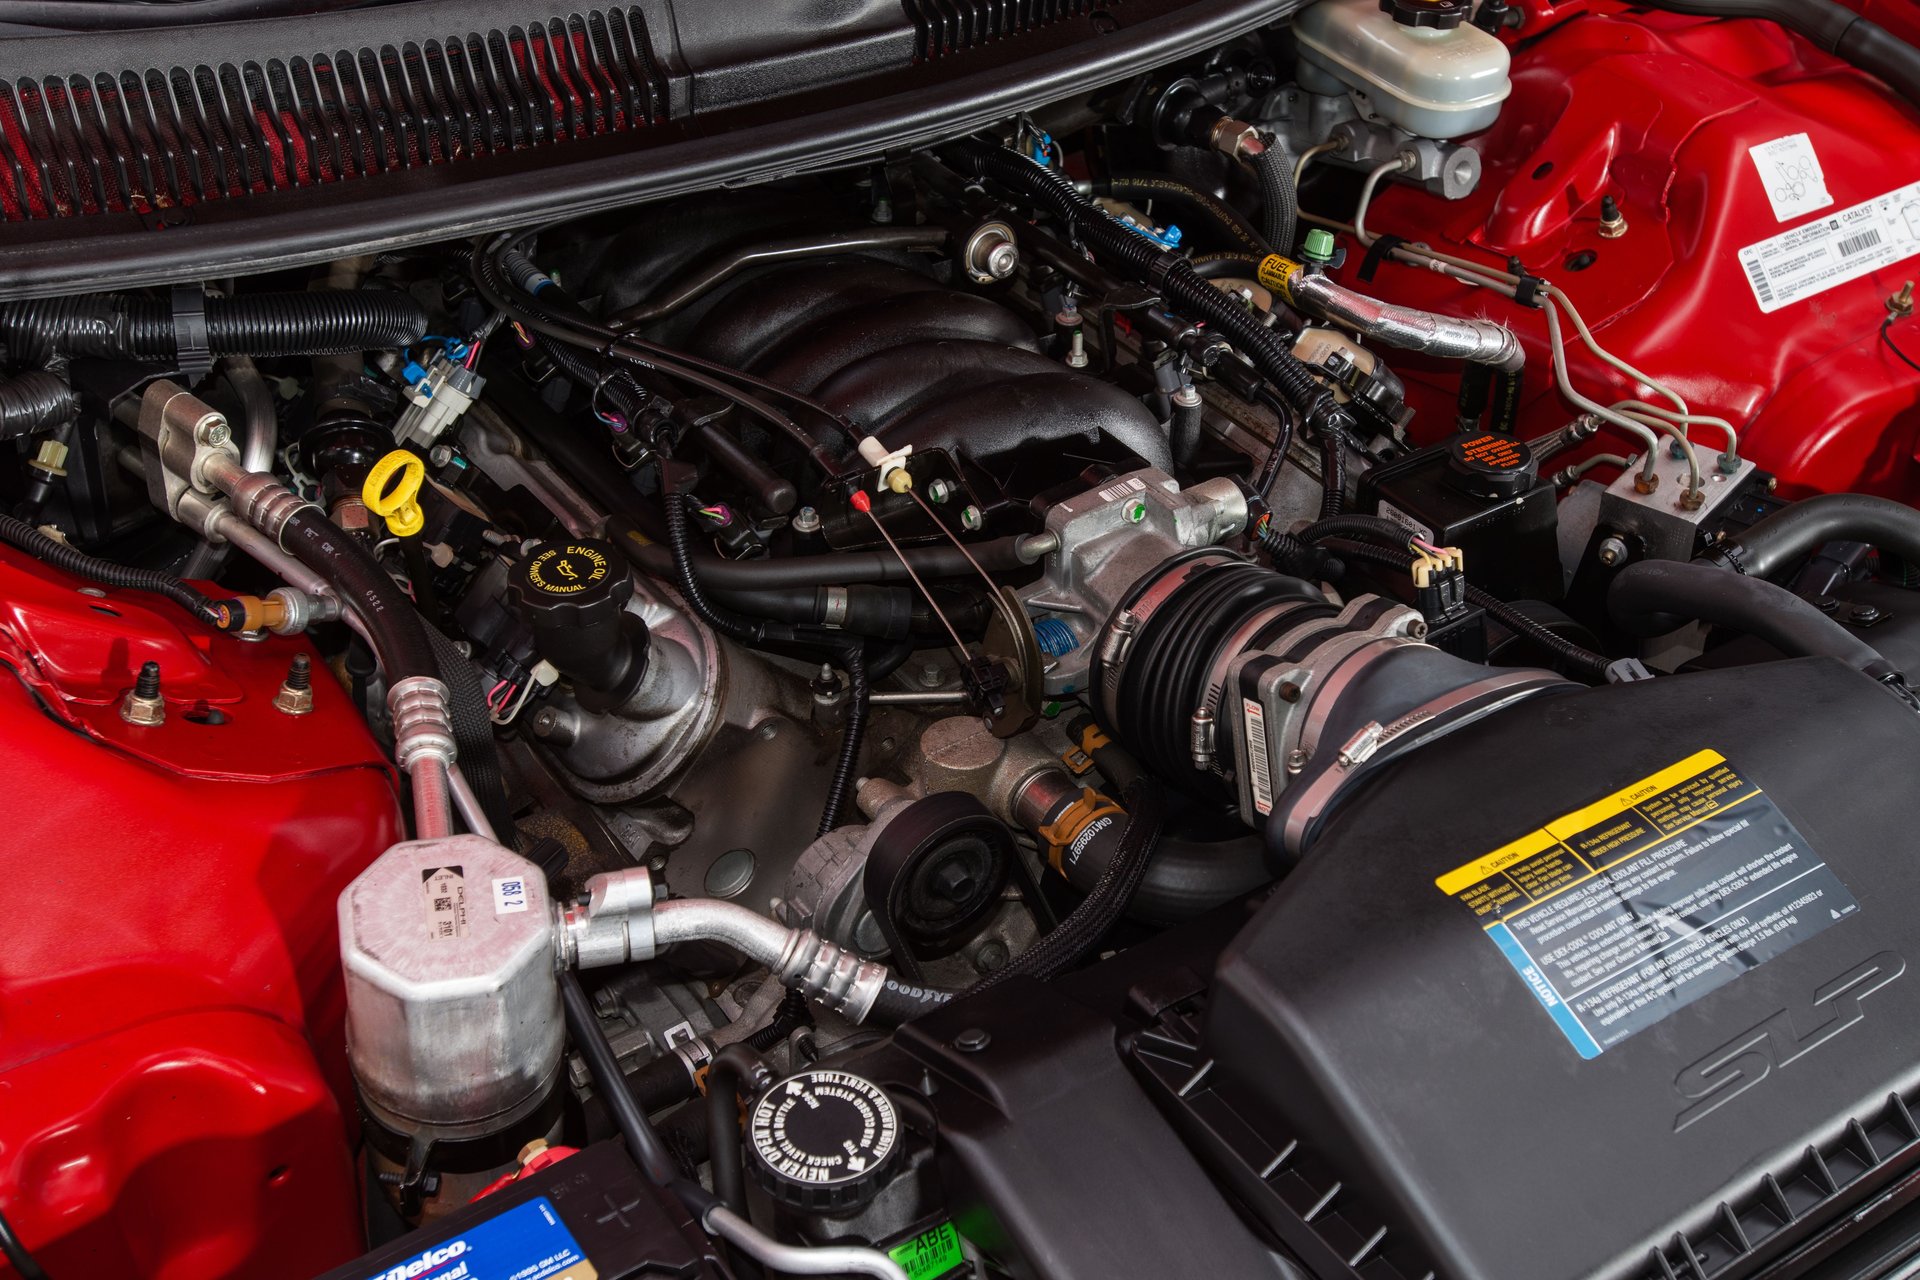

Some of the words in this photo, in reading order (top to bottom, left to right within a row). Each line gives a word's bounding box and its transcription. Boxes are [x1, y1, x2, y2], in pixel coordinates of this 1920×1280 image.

[1842, 205, 1872, 221] CATALYST
[1780, 237, 1799, 247] CONTROL
[1801, 225, 1829, 239] INFORMATION
[1783, 231, 1800, 240] VEHICLE
[1802, 222, 1822, 232] EMISSION
[1261, 267, 1286, 281] FLAMMABLE
[1265, 258, 1289, 274] FUEL
[1462, 435, 1494, 449] POWER
[1465, 440, 1508, 456] STEERING
[1491, 442, 1520, 453] OVERFILL
[1497, 449, 1513, 457] ONLY
[1489, 453, 1521, 466] APPROVED
[1500, 459, 1519, 468] FLUID
[538, 550, 556, 561] SEE
[567, 546, 606, 567] ENGINE
[588, 568, 606, 580] OIL
[529, 560, 546, 587] OWNER'S
[544, 584, 586, 593] MANUAL
[366, 590, 384, 613] 0522
[1246, 703, 1260, 712] FLOW
[1629, 784, 1657, 800] CAUTION
[1069, 817, 1113, 865] GM10295971
[1590, 845, 1609, 857] UNDER
[1606, 839, 1621, 849] HIGH
[1618, 826, 1646, 843] PRESSURE
[1597, 821, 1632, 841] REFRIGERANT
[1489, 851, 1519, 868] CAUTION
[501, 881, 522, 896] 058
[1512, 918, 1530, 930] THIS
[1527, 905, 1555, 923] VEHICLE
[1552, 890, 1584, 910] REQUIRES
[1586, 876, 1614, 893] SPECIAL
[1611, 862, 1642, 881] COOLANT
[1639, 856, 1654, 867] FILL
[1650, 839, 1688, 861] PROCEDURE
[1528, 922, 1547, 934] Read
[1543, 912, 1567, 927] Service
[1564, 901, 1587, 916] Manual
[1594, 888, 1614, 901] before
[1612, 879, 1632, 893] adding
[1639, 865, 1661, 878] coolant
[1664, 851, 1687, 866] system.
[1683, 843, 1704, 856] Failure
[1707, 832, 1725, 844] follow
[1721, 823, 1743, 837] special
[457, 886, 466, 925] DELPHI
[1536, 925, 1567, 944] procedure
[1563, 917, 1581, 929] could
[1579, 909, 1597, 921] result
[1600, 896, 1623, 910] serious
[1620, 885, 1644, 901] damage
[1656, 868, 1679, 883] engine.
[1568, 948, 1591, 963] vehicle
[1598, 929, 1626, 947] extended
[1670, 893, 1697, 911] improper
[1717, 871, 1738, 885] coolant
[1744, 856, 1766, 871] shorten
[1772, 842, 1793, 856] coolant
[1573, 956, 1601, 973] requiring
[1598, 945, 1621, 960] change
[1618, 936, 1637, 949] much
[1748, 865, 1773, 881] extended
[1779, 852, 1799, 866] engine
[443, 921, 453, 937] 3101
[1539, 953, 1556, 965] USE
[1587, 920, 1618, 940] COOLANT
[1615, 912, 1635, 925] ONLY
[1638, 936, 1660, 951] Manual
[1575, 994, 1602, 1012] R-134a
[1597, 972, 1643, 1000] REFRIGERANT
[1638, 964, 1659, 979] (FOR
[1653, 958, 1668, 970] AIR
[1664, 937, 1707, 965] CONDITIONED
[1703, 924, 1732, 943] VEHICLES
[1728, 915, 1750, 931] ONLY)
[1603, 999, 1620, 1011] only
[1635, 973, 1668, 994] refrigerant
[1757, 910, 1784, 928] synthetic
[1521, 966, 1561, 1007] NOTICE
[1599, 1006, 1632, 1027] equivalent
[1655, 980, 1678, 996] system
[1736, 937, 1758, 952] charge
[1673, 951, 1906, 1133] SLP
[810, 1073, 841, 1083] TUBE
[840, 1075, 870, 1093] VENT
[813, 1086, 855, 1101] SYSTEM
[867, 1089, 878, 1100] &
[755, 1101, 777, 1126] HOT
[773, 1096, 797, 1129] BOTTLE
[852, 1097, 875, 1127] CLOSED
[873, 1098, 895, 1129] ARROW
[755, 1129, 782, 1162] OPEN
[774, 1129, 787, 1141] IN
[872, 1129, 894, 1158] ALIGN
[780, 1139, 807, 1165] LEVEL
[805, 1154, 843, 1167] CHECK
[779, 1157, 829, 1182] NEVER
[915, 1225, 950, 1255] ABE
